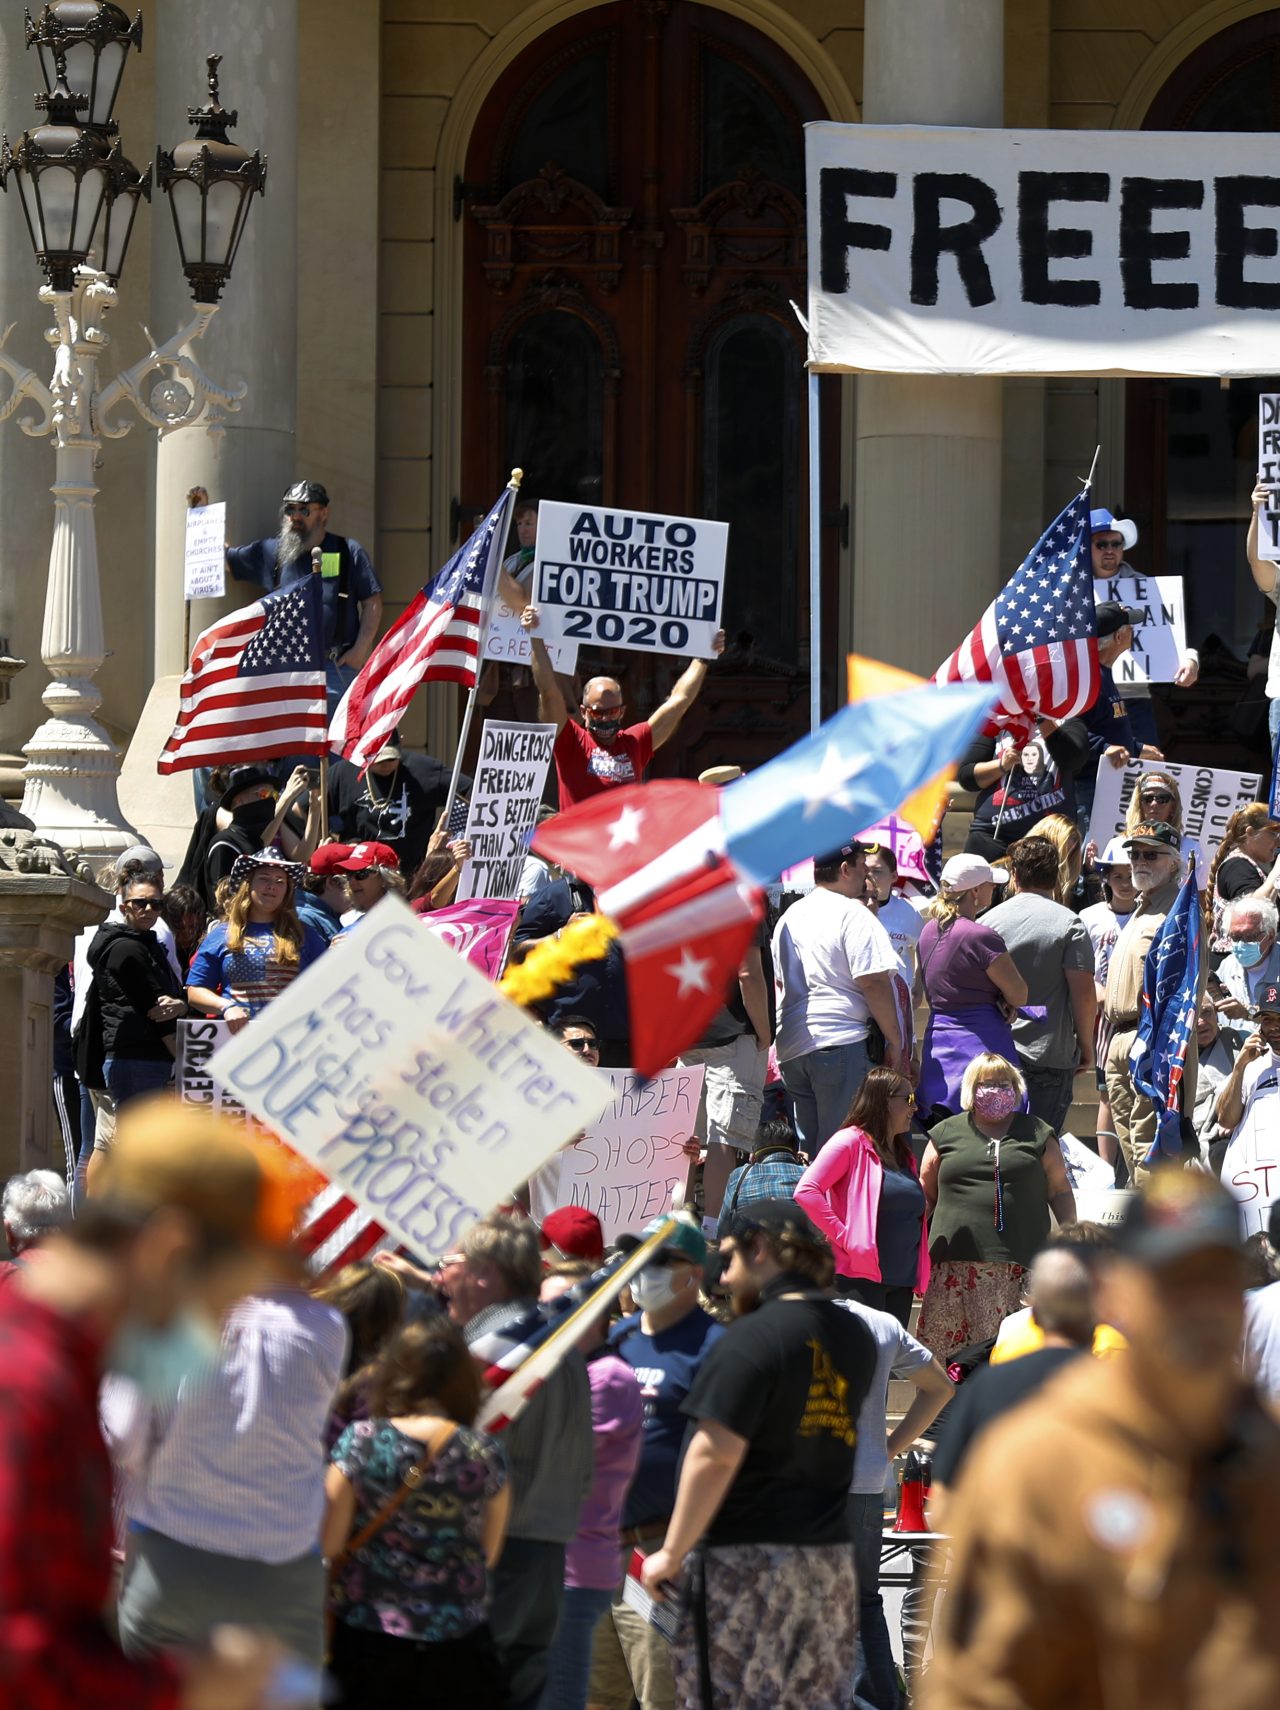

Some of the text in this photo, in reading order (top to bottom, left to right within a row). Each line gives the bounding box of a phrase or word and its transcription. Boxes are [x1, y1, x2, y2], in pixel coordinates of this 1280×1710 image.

[570, 512, 697, 548] AUTO
[569, 537, 695, 575] WORKERS
[541, 565, 716, 619] FOR TRUMP
[562, 610, 690, 649] 2020
[487, 636, 562, 665] GRET!
[483, 731, 554, 763] DANGEROUS
[478, 767, 536, 795] FREEDOM
[471, 799, 499, 828] IS
[1184, 768, 1214, 842] CONSTITU
[470, 832, 505, 858] THAN
[183, 1022, 218, 1105] GEROUS
[320, 973, 512, 1154] has stolen
[599, 1074, 691, 1124] ARBER
[228, 1036, 484, 1256] DUE PROCESS
[574, 1131, 686, 1175] SHOPS
